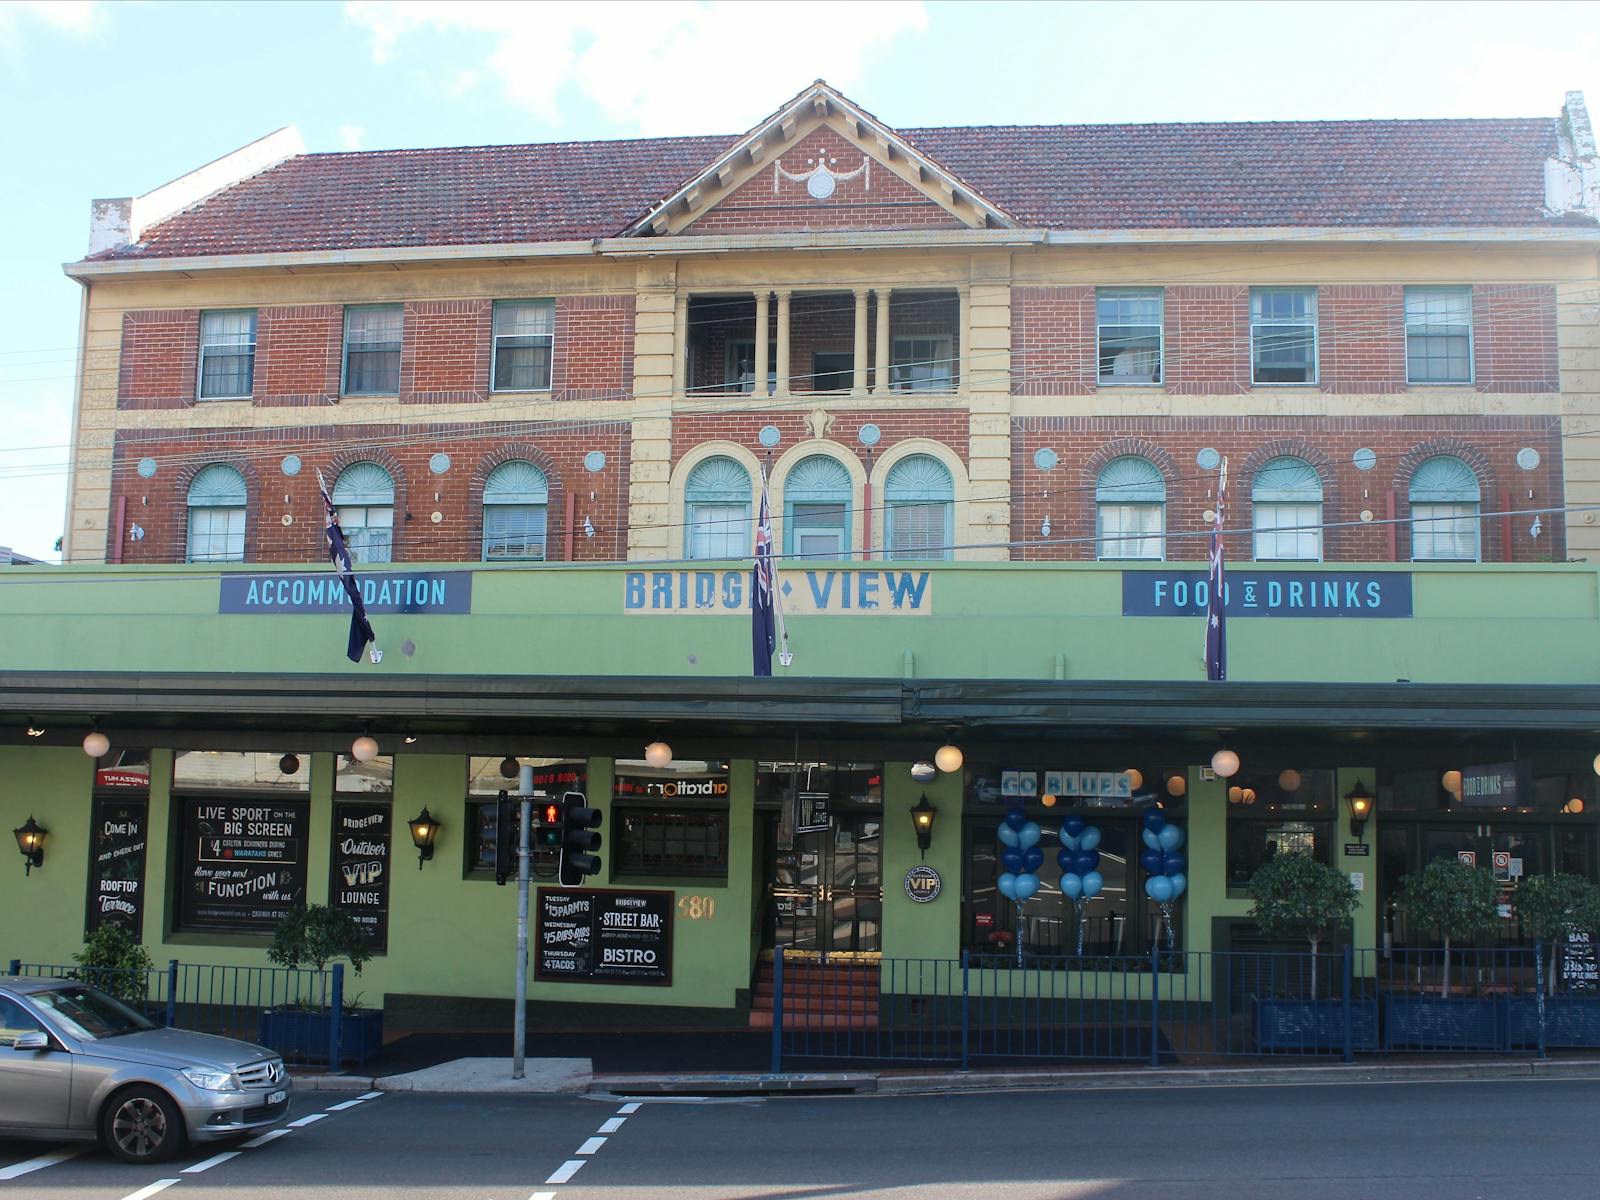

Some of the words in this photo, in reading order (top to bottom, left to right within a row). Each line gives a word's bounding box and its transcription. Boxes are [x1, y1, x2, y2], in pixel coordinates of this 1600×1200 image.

[805, 571, 930, 609] VIEW
[1243, 582, 1258, 607] &
[1268, 581, 1382, 608] DRINKS
[1003, 775, 1037, 795] GO
[1046, 775, 1130, 795] BLUES
[198, 806, 226, 820] LIVE
[232, 807, 272, 821] SPORT
[104, 821, 127, 836] COME
[128, 821, 138, 836] IN
[343, 814, 384, 829] BRIDGEVIEW
[223, 822, 243, 835] BIG
[247, 823, 292, 837] SCREEN
[340, 838, 387, 856] Outdoor
[341, 861, 383, 887] VIP
[100, 880, 138, 892] ROOFTOP
[208, 871, 277, 898] FUNCTION
[910, 878, 937, 890] VIP
[99, 895, 137, 915] Terrace
[341, 891, 380, 905] LOUNGE
[603, 912, 639, 928] STREET
[640, 914, 660, 928] BAR
[1568, 933, 1590, 943] BAR
[543, 950, 577, 958] THURSDAY
[603, 948, 657, 964] BISTRO
